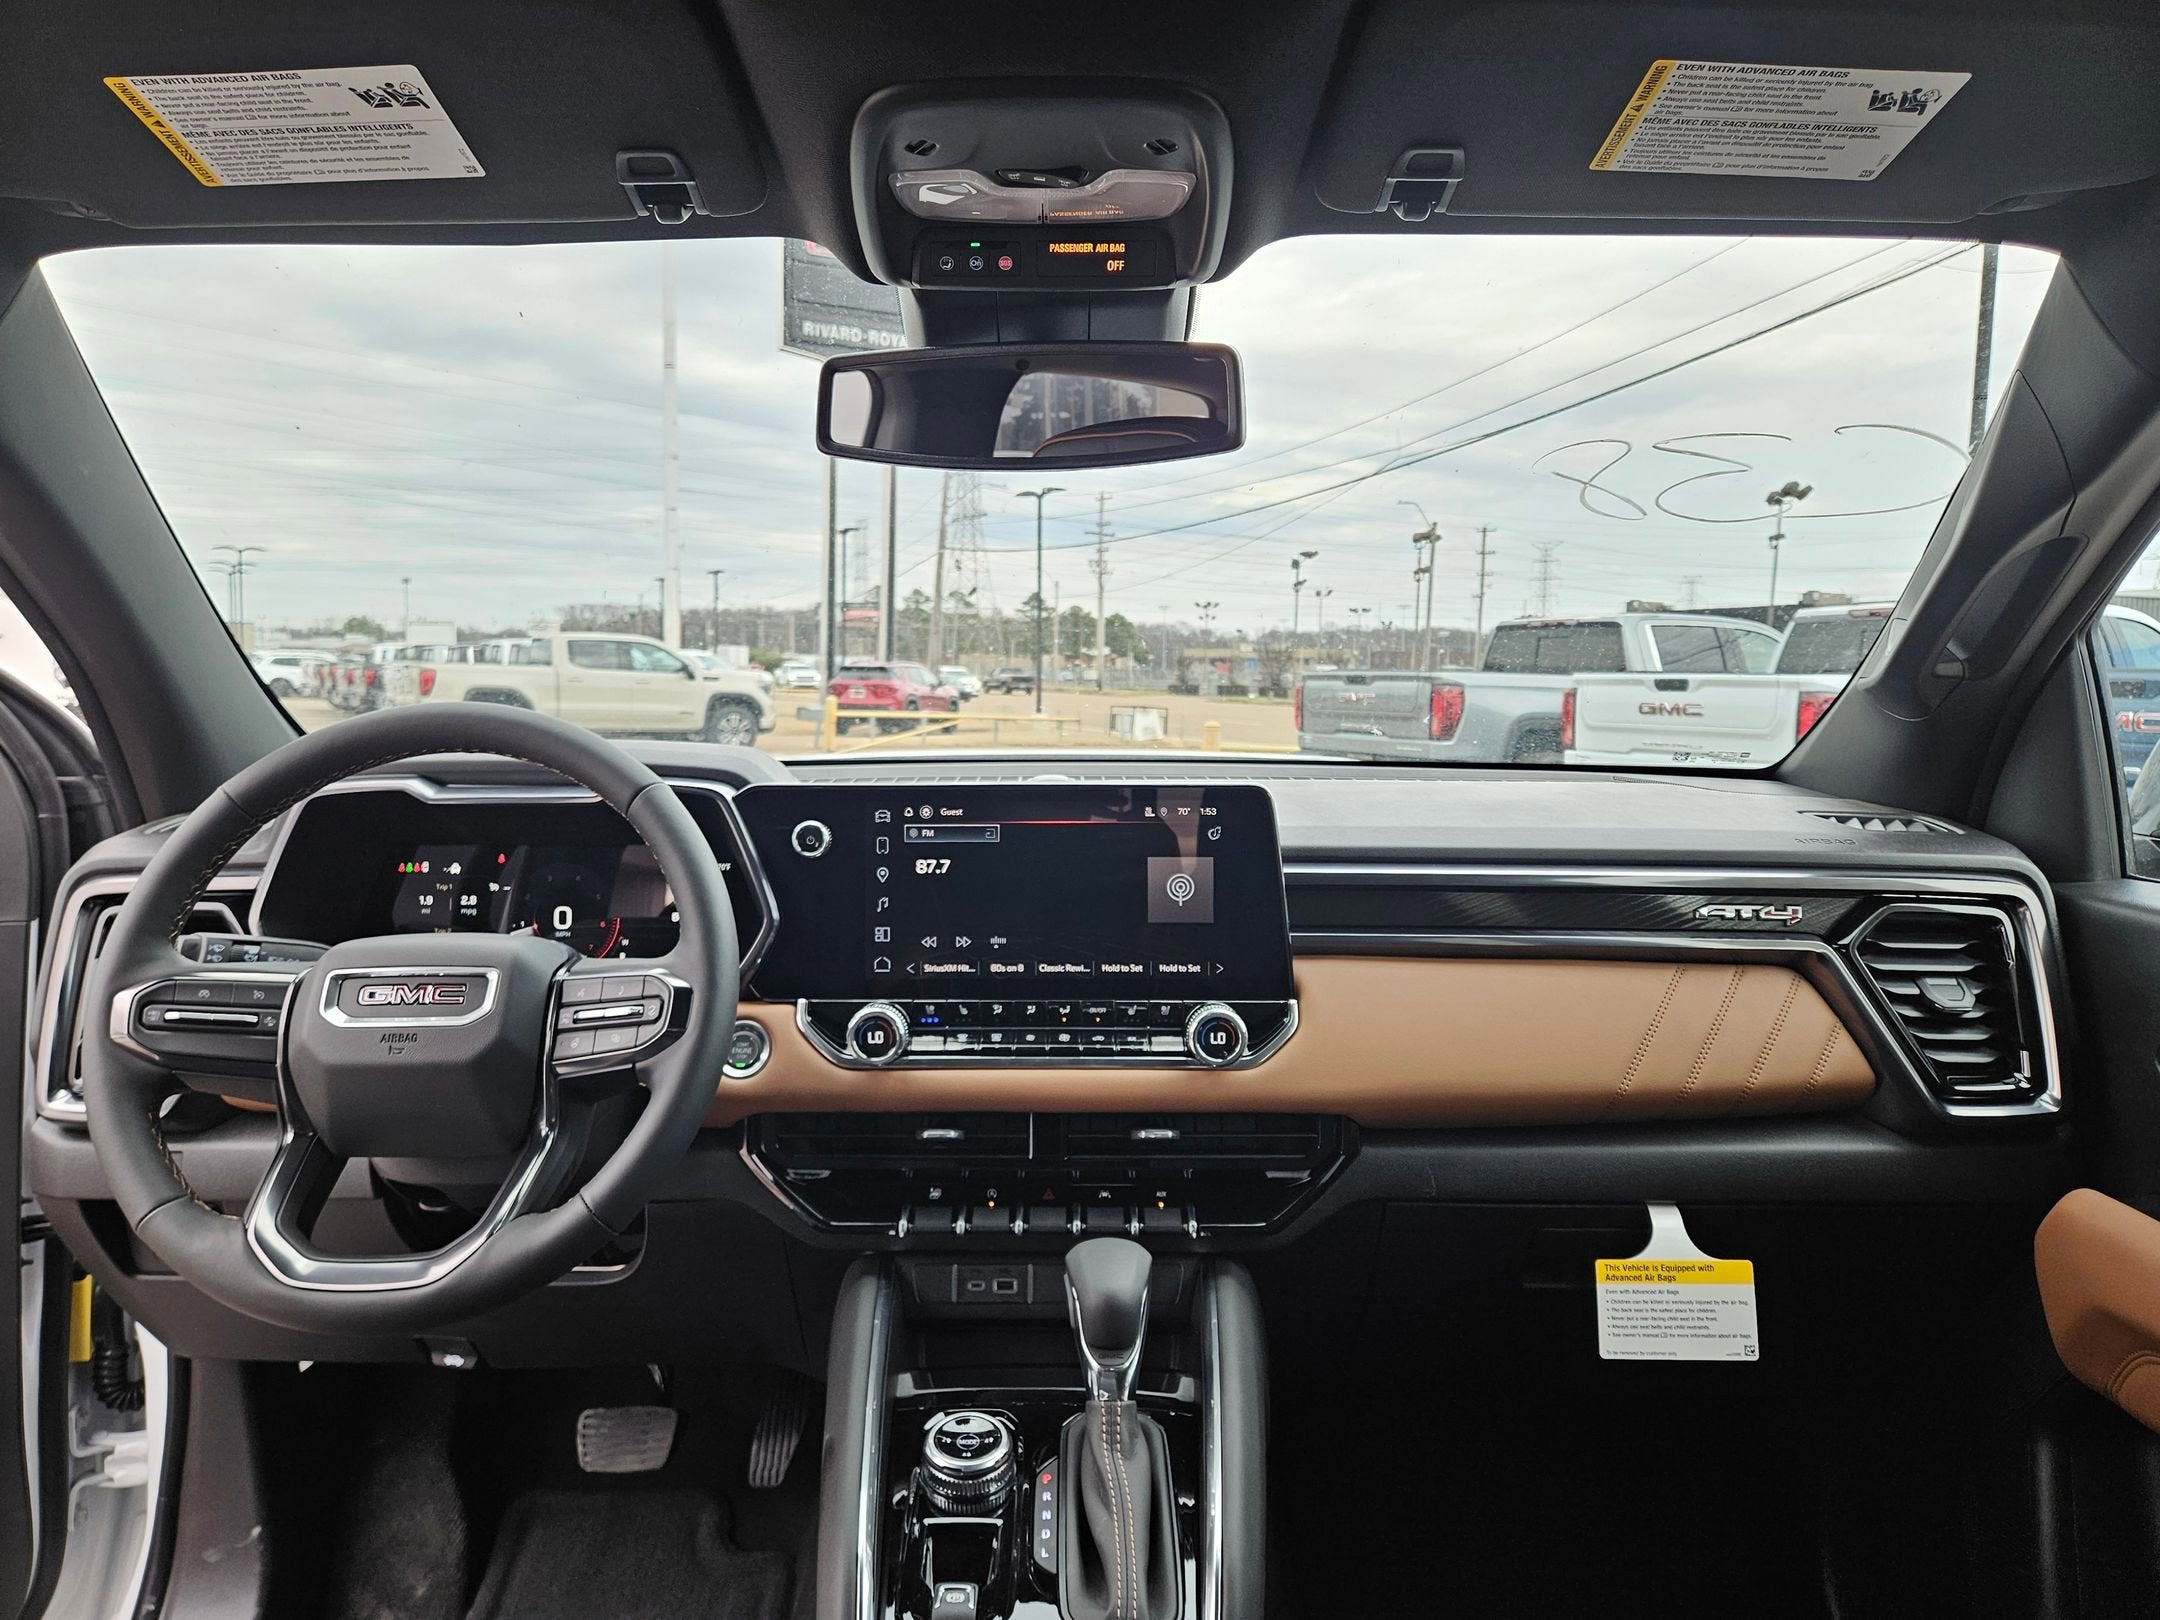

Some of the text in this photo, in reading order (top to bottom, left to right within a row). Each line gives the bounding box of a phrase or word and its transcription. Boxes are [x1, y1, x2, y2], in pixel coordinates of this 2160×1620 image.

[1676, 63, 1850, 79] EVEN WITH ADVANCED AIR BAGS
[130, 72, 303, 86] EVEN WITH ADVANCED AIR BAGS
[1636, 65, 1668, 102] WARNING
[113, 82, 155, 119] WARNING
[1641, 116, 1879, 133] MÊME AVEC DES SACS GONFLABLES INTELLIGENTS
[212, 129, 239, 138] AVEC
[237, 128, 259, 136] DES
[258, 127, 286, 136] SACS
[285, 125, 348, 135] GONFLABLES
[347, 123, 415, 132] INTELLIGENTS
[1595, 113, 1637, 168] AVERTISSEMENT
[1049, 243, 1126, 253] PASSENGER AIR BAG
[1106, 259, 1126, 272] OFF
[1638, 702, 1704, 717] GMC
[940, 808, 964, 816] Guest
[1177, 807, 1191, 816] 70°
[1200, 807, 1217, 816] 1:53
[921, 829, 935, 838] FM
[1794, 836, 1857, 847] AIRBAG
[915, 858, 951, 874] 87.7
[460, 908, 478, 917] mpg
[553, 905, 573, 930] 0
[1695, 904, 1803, 926] AT4
[923, 963, 957, 973] SiriusXM
[1006, 964, 1018, 973] on
[1038, 963, 1065, 973] Classic
[1101, 963, 1144, 973] Hold to Set
[1159, 963, 1201, 973] Hold to Set
[356, 983, 468, 1008] GMC
[380, 1032, 418, 1044] AIRBAG
[867, 1031, 885, 1045] LO
[1209, 1031, 1227, 1045] LO
[1604, 1264, 1715, 1273] This Vehicle is Equipped with
[1605, 1273, 1677, 1283] Advanced Air Bags
[1041, 1473, 1053, 1485] P
[1042, 1491, 1052, 1501] R
[1041, 1510, 1052, 1520] N
[1041, 1528, 1051, 1539] D
[1041, 1547, 1050, 1558] L
